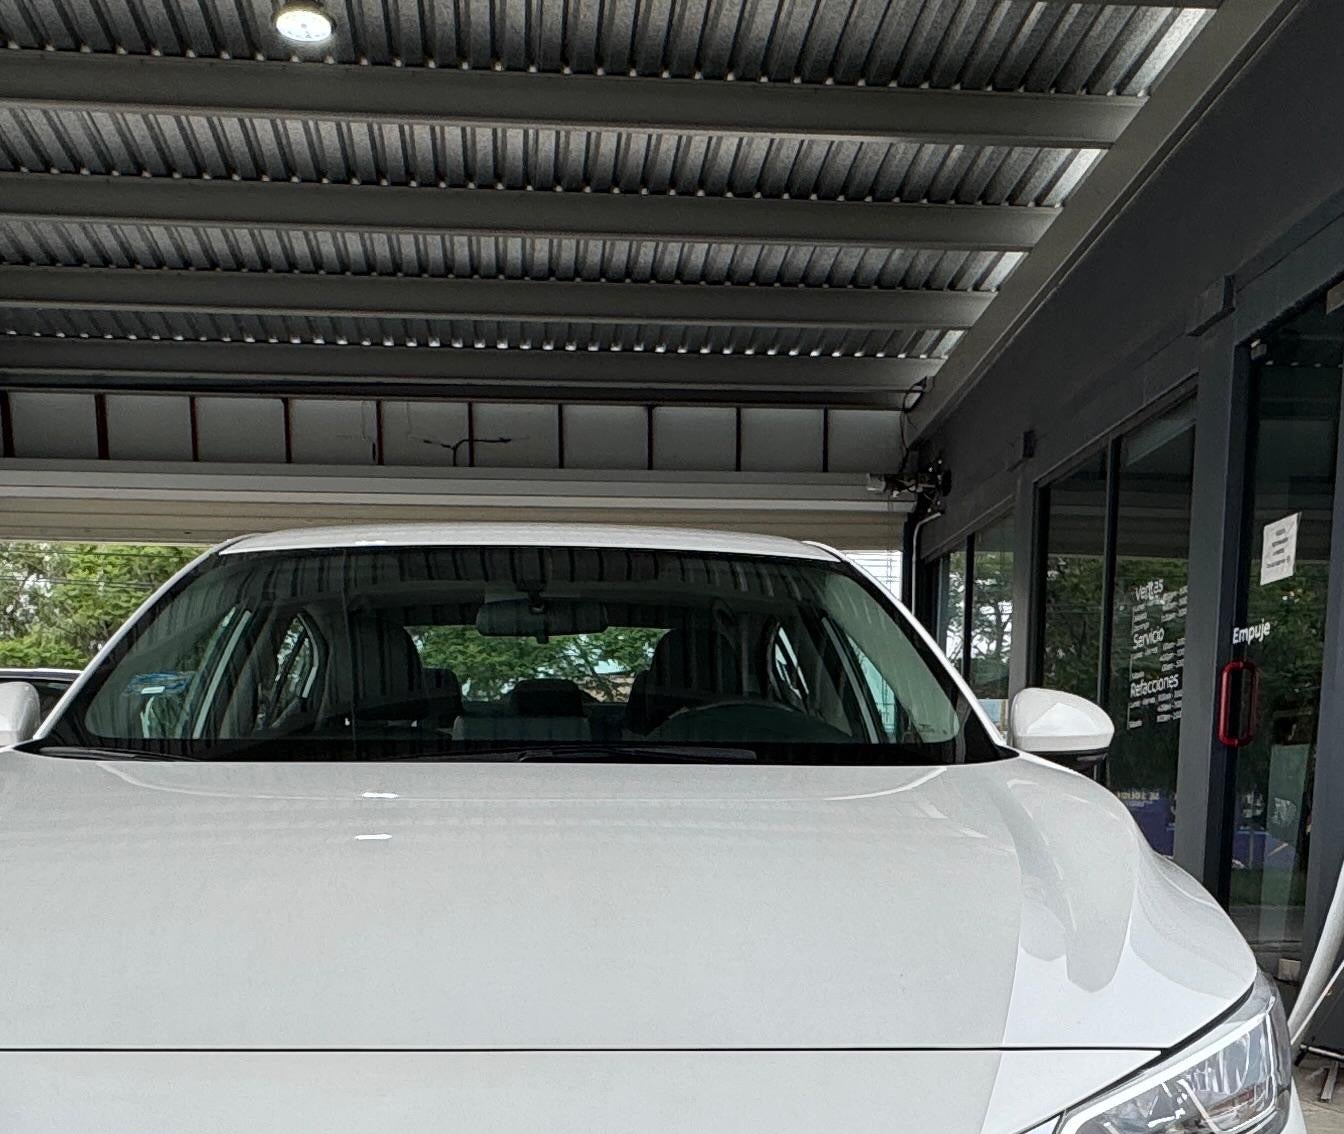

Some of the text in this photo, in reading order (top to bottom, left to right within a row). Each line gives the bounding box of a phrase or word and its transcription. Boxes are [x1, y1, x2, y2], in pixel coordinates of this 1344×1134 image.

[1133, 627, 1164, 650] Servicio
[1232, 619, 1271, 645] Empuje
[1130, 673, 1179, 698] Refacciones
